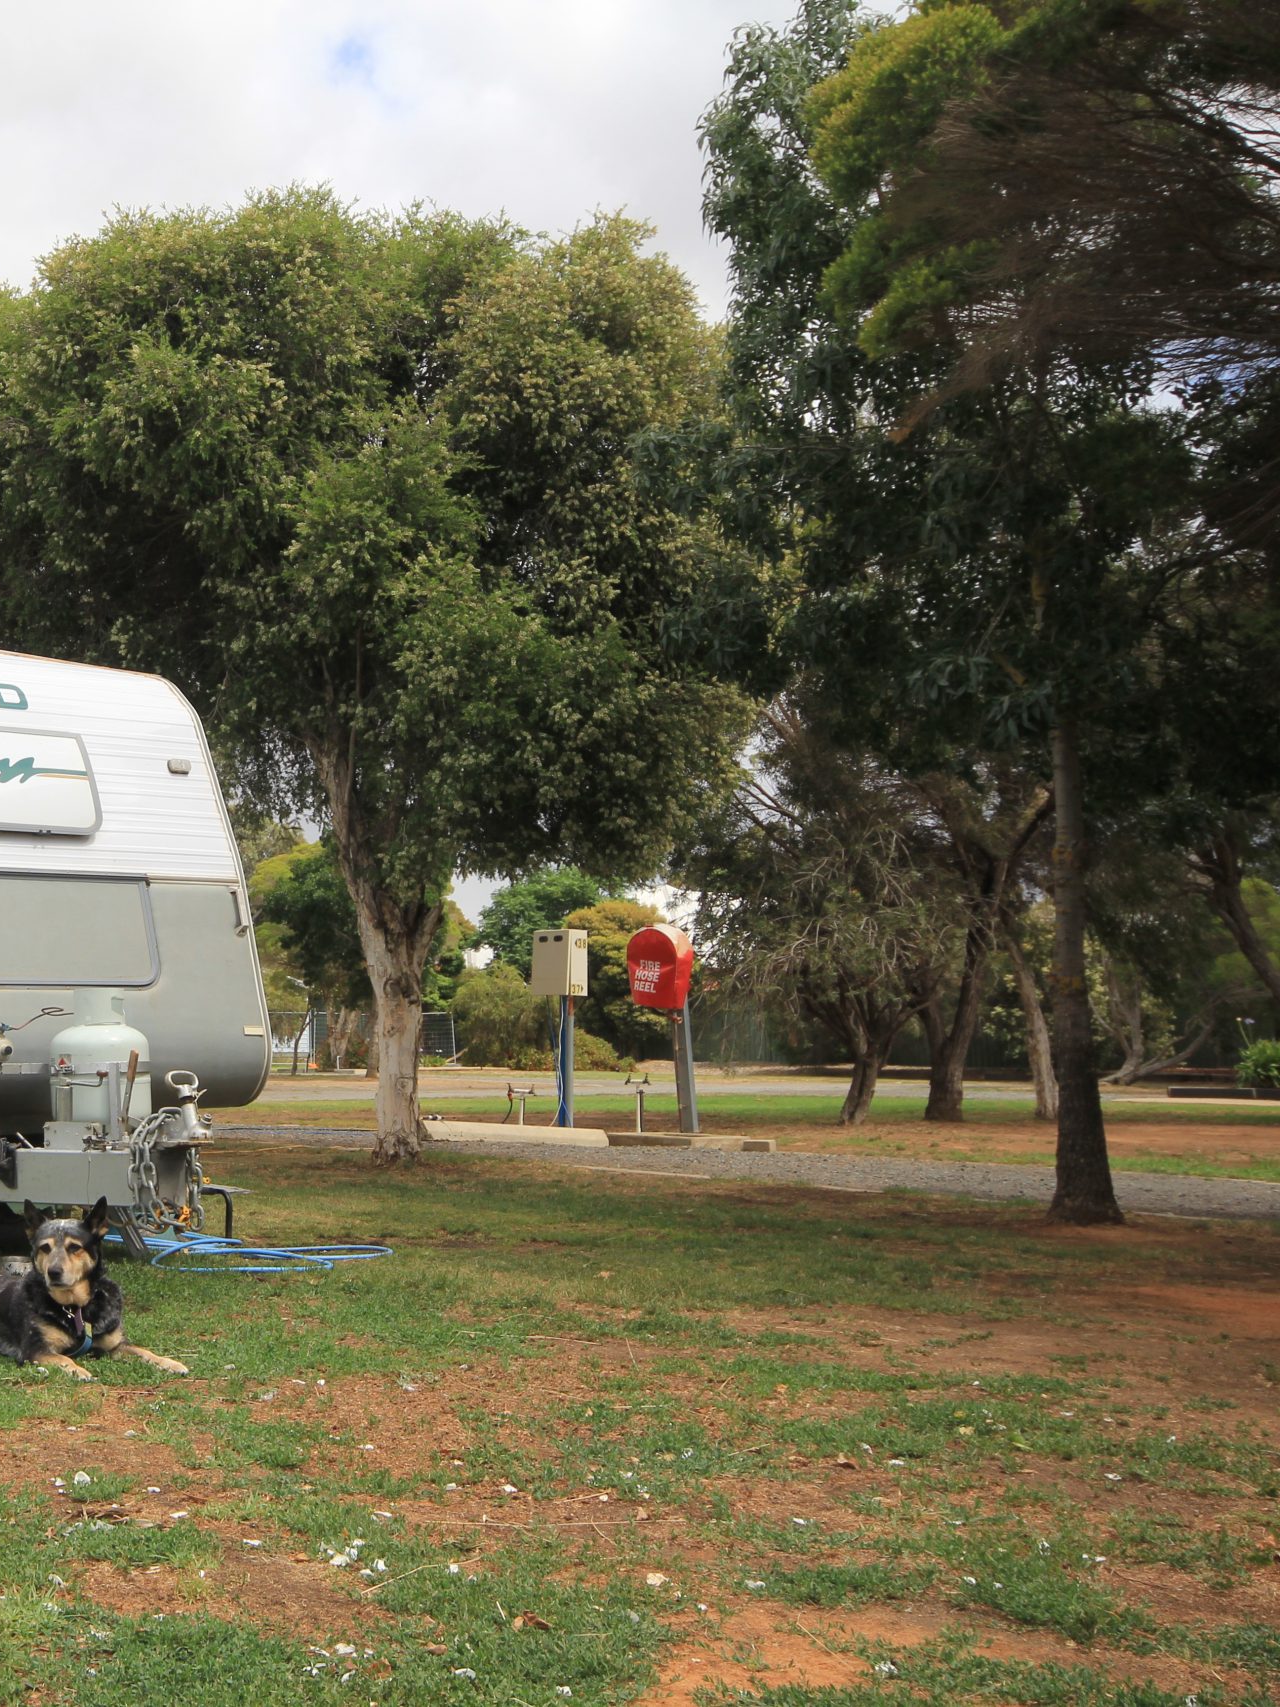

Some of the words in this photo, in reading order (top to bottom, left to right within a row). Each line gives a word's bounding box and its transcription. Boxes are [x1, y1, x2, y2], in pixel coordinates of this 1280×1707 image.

[640, 959, 661, 971] FIRE
[635, 970, 660, 982] HOSE
[571, 984, 580, 994] 37
[634, 981, 657, 993] REEL
